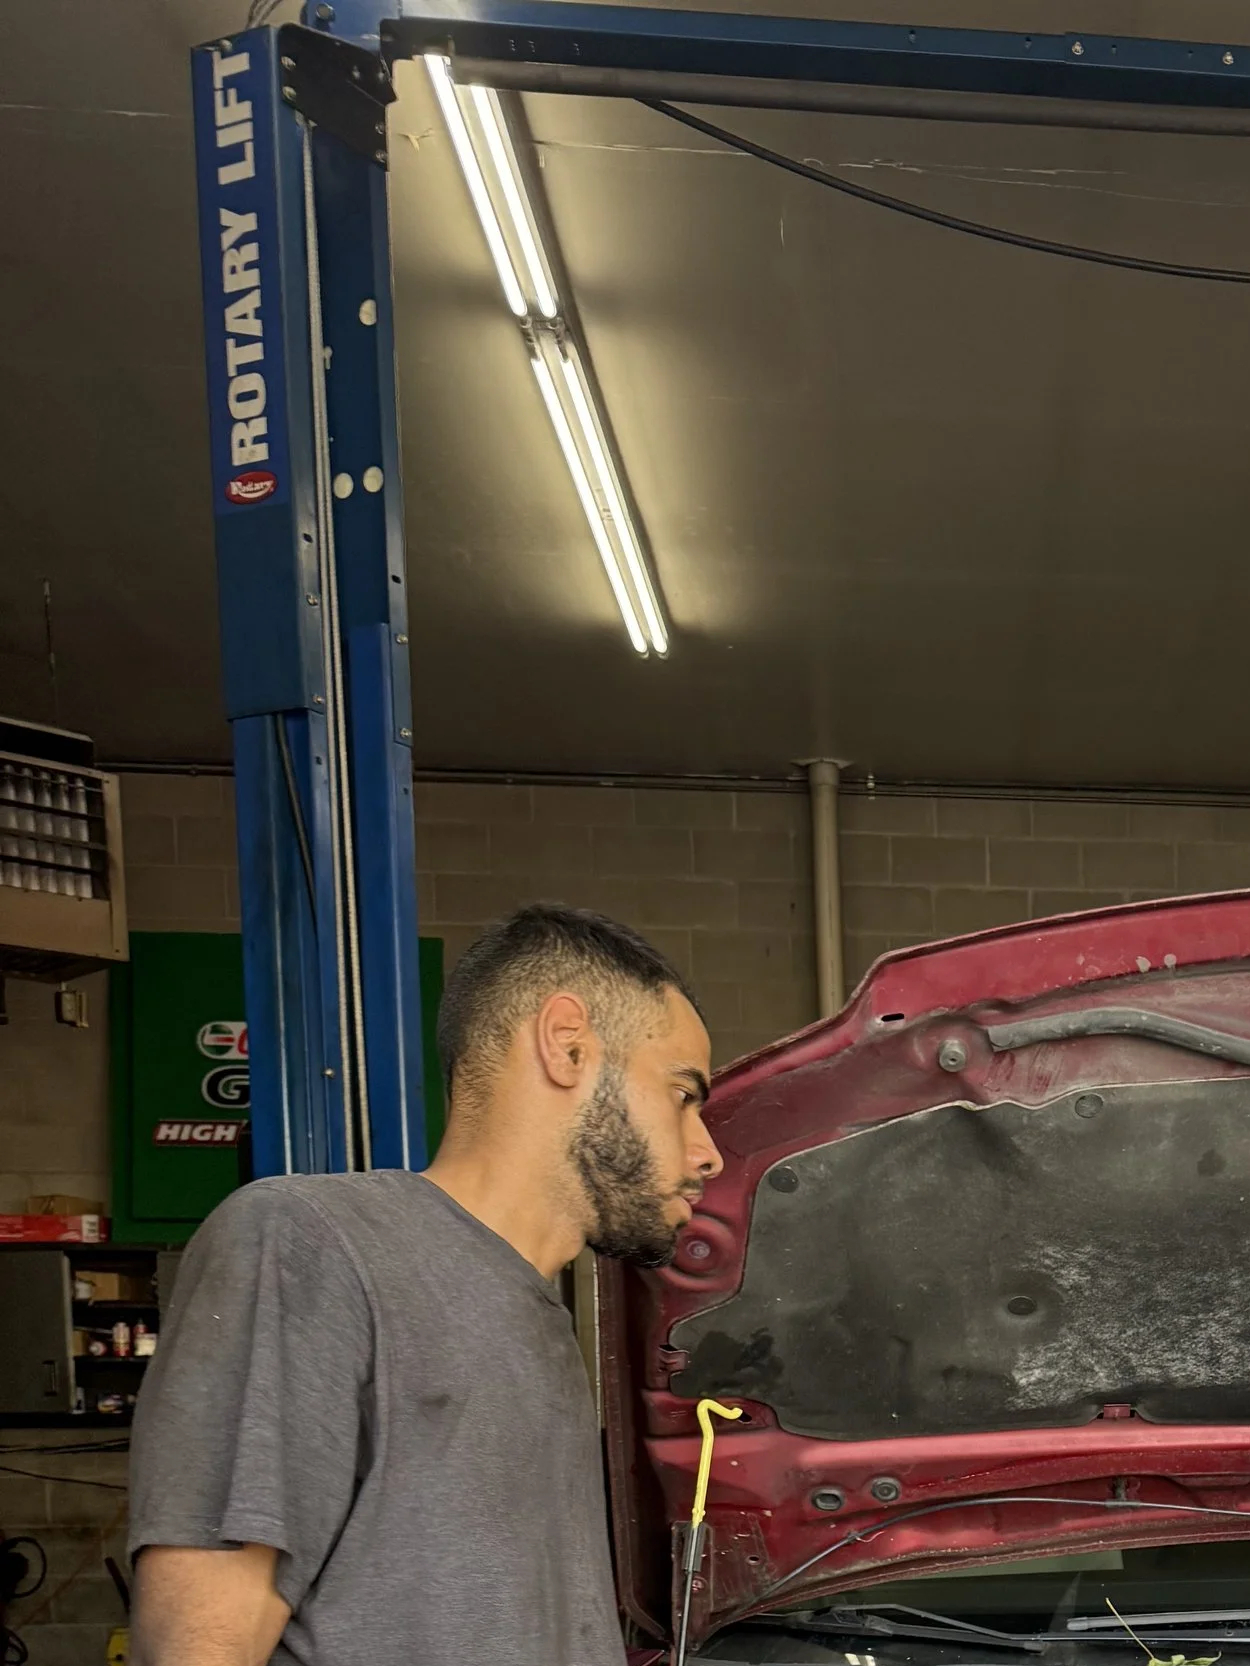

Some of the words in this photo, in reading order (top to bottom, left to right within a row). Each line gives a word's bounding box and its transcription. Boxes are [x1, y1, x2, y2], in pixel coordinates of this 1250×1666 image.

[211, 50, 257, 188] LIFT
[219, 206, 270, 466] ROTARY
[230, 480, 274, 498] Rotary
[156, 1123, 238, 1141] HIGH
